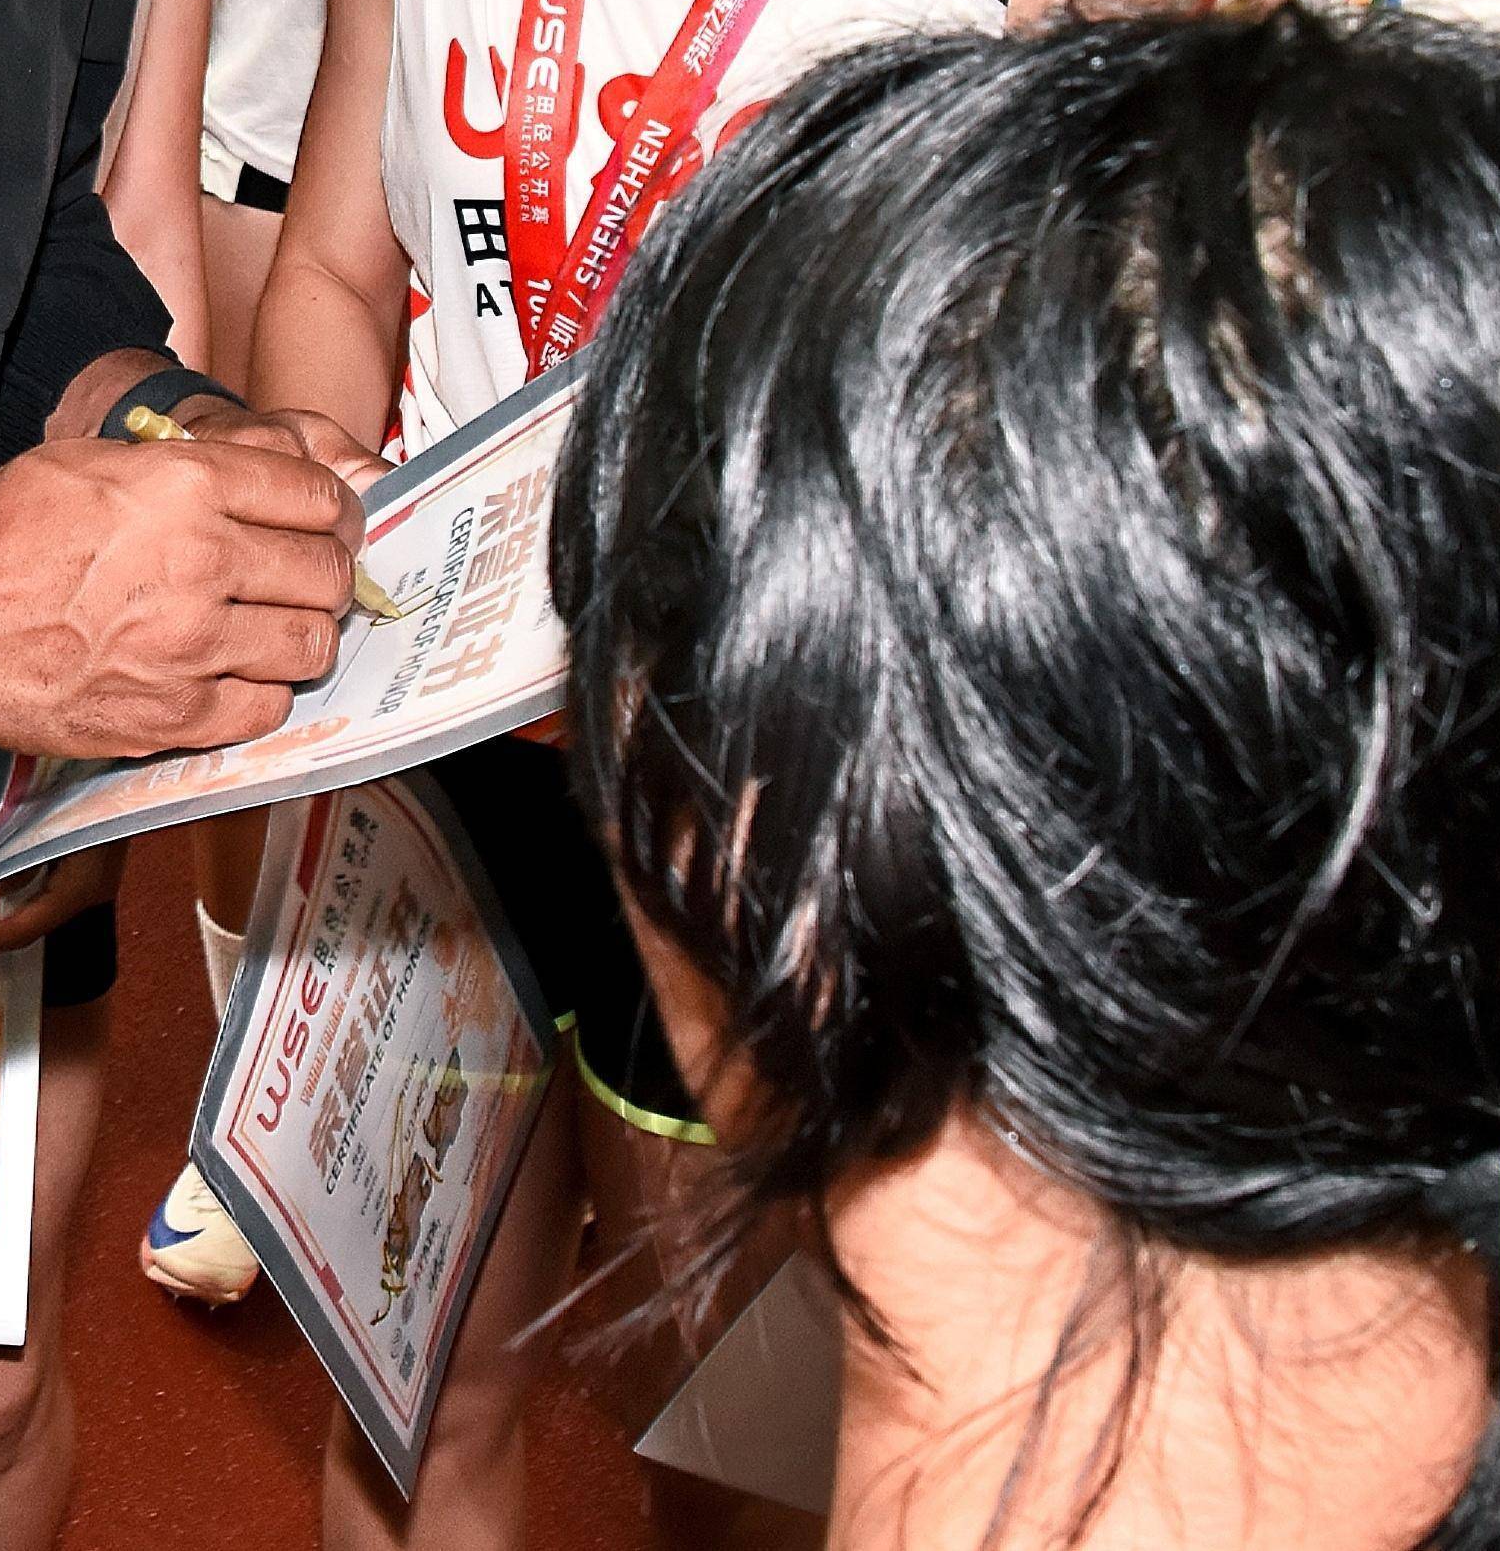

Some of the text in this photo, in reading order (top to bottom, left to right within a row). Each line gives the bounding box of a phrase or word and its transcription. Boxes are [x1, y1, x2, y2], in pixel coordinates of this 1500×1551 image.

[520, 94, 535, 222] ATHLETICS OPEN
[530, 94, 555, 225] 田径公开赛
[575, 119, 673, 291] SHENZHEN
[417, 464, 550, 698] 荣誉证书
[422, 506, 475, 627] CERTIFICATE
[371, 648, 430, 720] HONOR
[257, 961, 331, 1133] WSE
[325, 1045, 386, 1195] CERTIFICATE
[381, 1008, 404, 1047] OF
